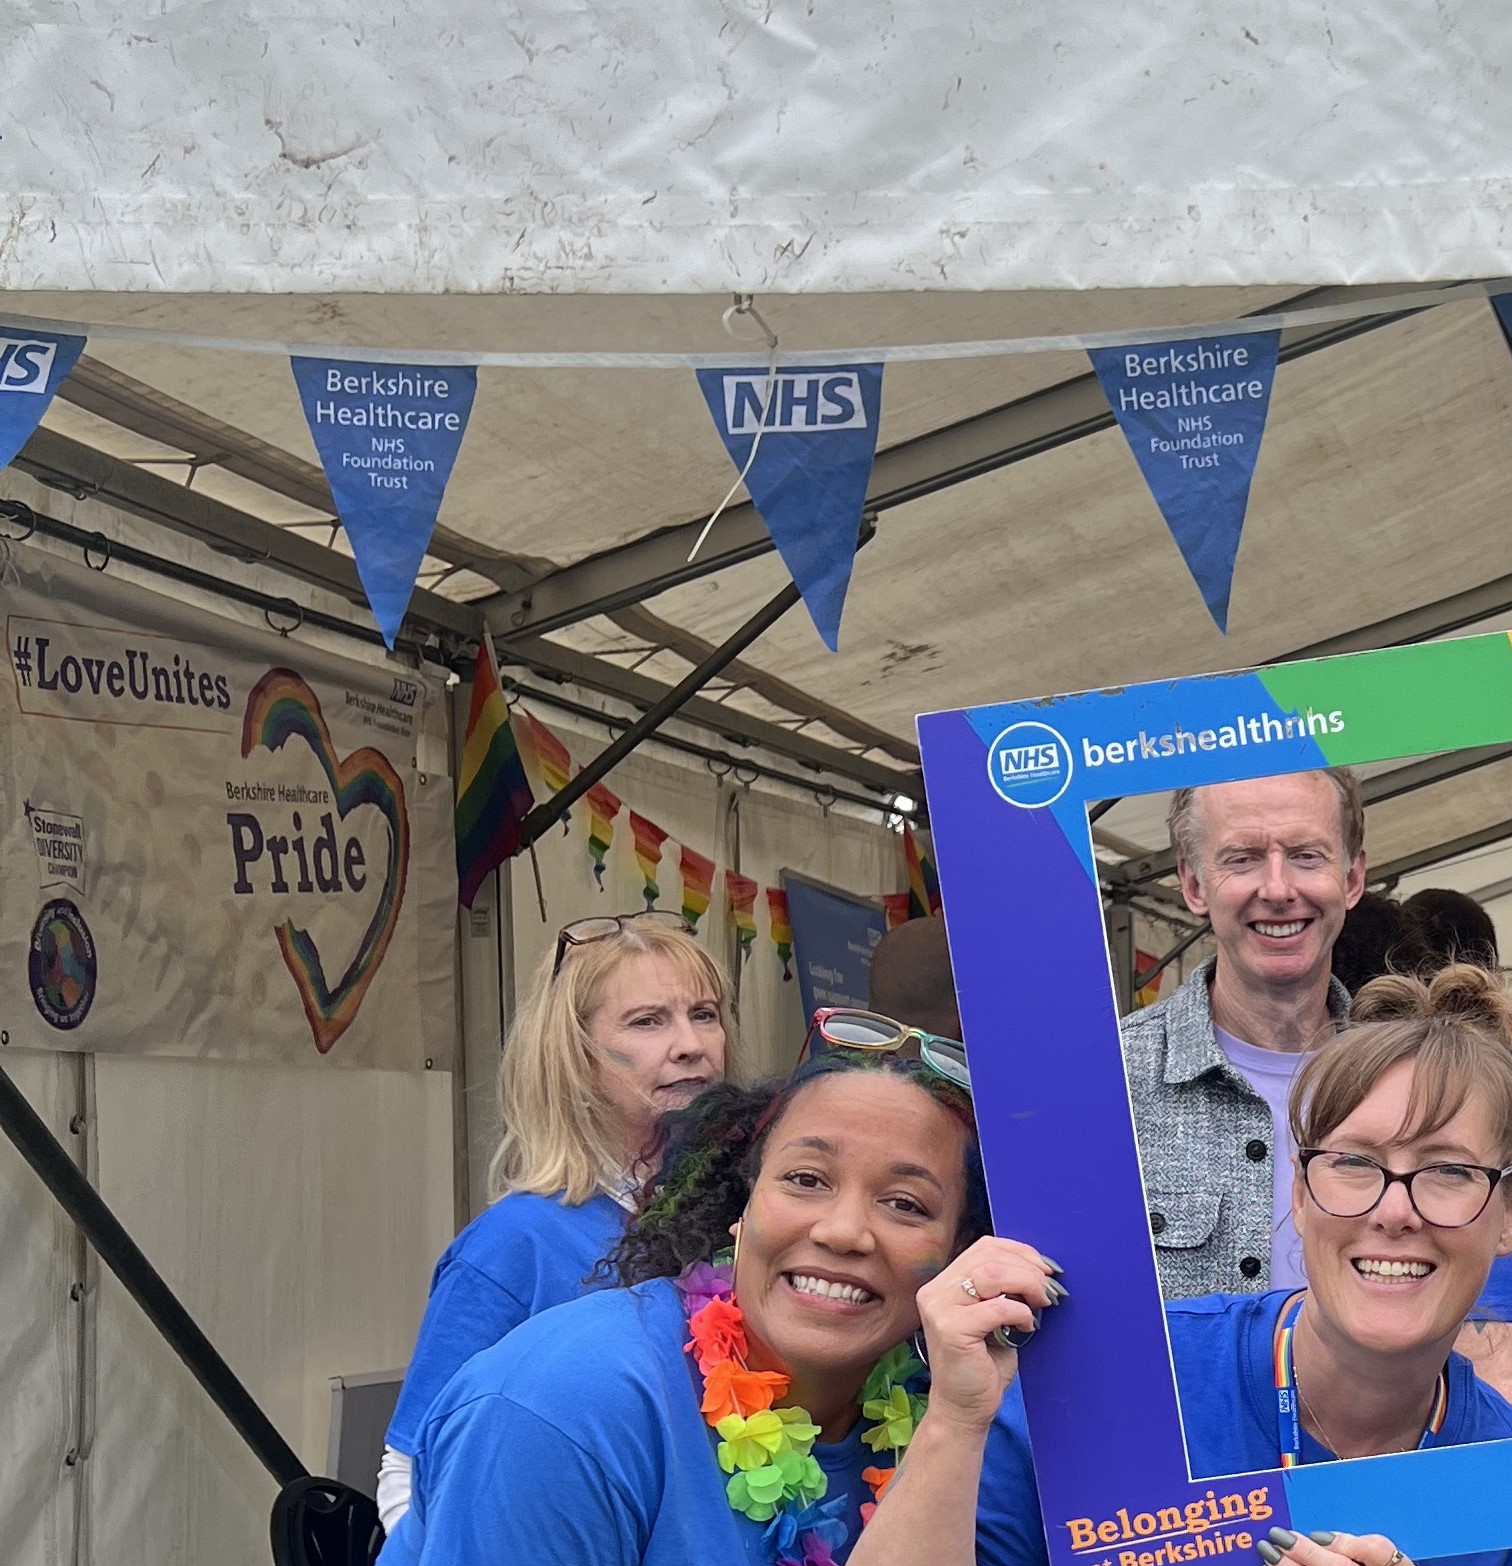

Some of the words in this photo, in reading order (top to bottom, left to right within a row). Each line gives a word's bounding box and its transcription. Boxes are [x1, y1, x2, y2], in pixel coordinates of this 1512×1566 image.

[1125, 343, 1249, 377] Berkshire
[326, 369, 449, 398] Berkshire
[1119, 380, 1263, 411] Healthcare
[316, 400, 461, 431] Healthcare
[732, 377, 855, 429] NHS
[1178, 415, 1213, 433] NHS
[372, 437, 405, 453] NHS
[1151, 431, 1244, 453] Foundation
[342, 453, 435, 472] Foundation
[1180, 453, 1220, 469] Trust
[368, 473, 408, 489] Trust
[13, 636, 231, 710] #LoveUnites
[1082, 706, 1345, 769] berkshealthnhs
[1004, 745, 1055, 772] NHS
[225, 781, 275, 801] Berkshire
[278, 784, 329, 804] Healthcare
[34, 816, 81, 840] Stonewall
[37, 837, 83, 863] DIVERSITY
[226, 811, 367, 894] Pride
[1066, 1486, 1273, 1550] Belonging
